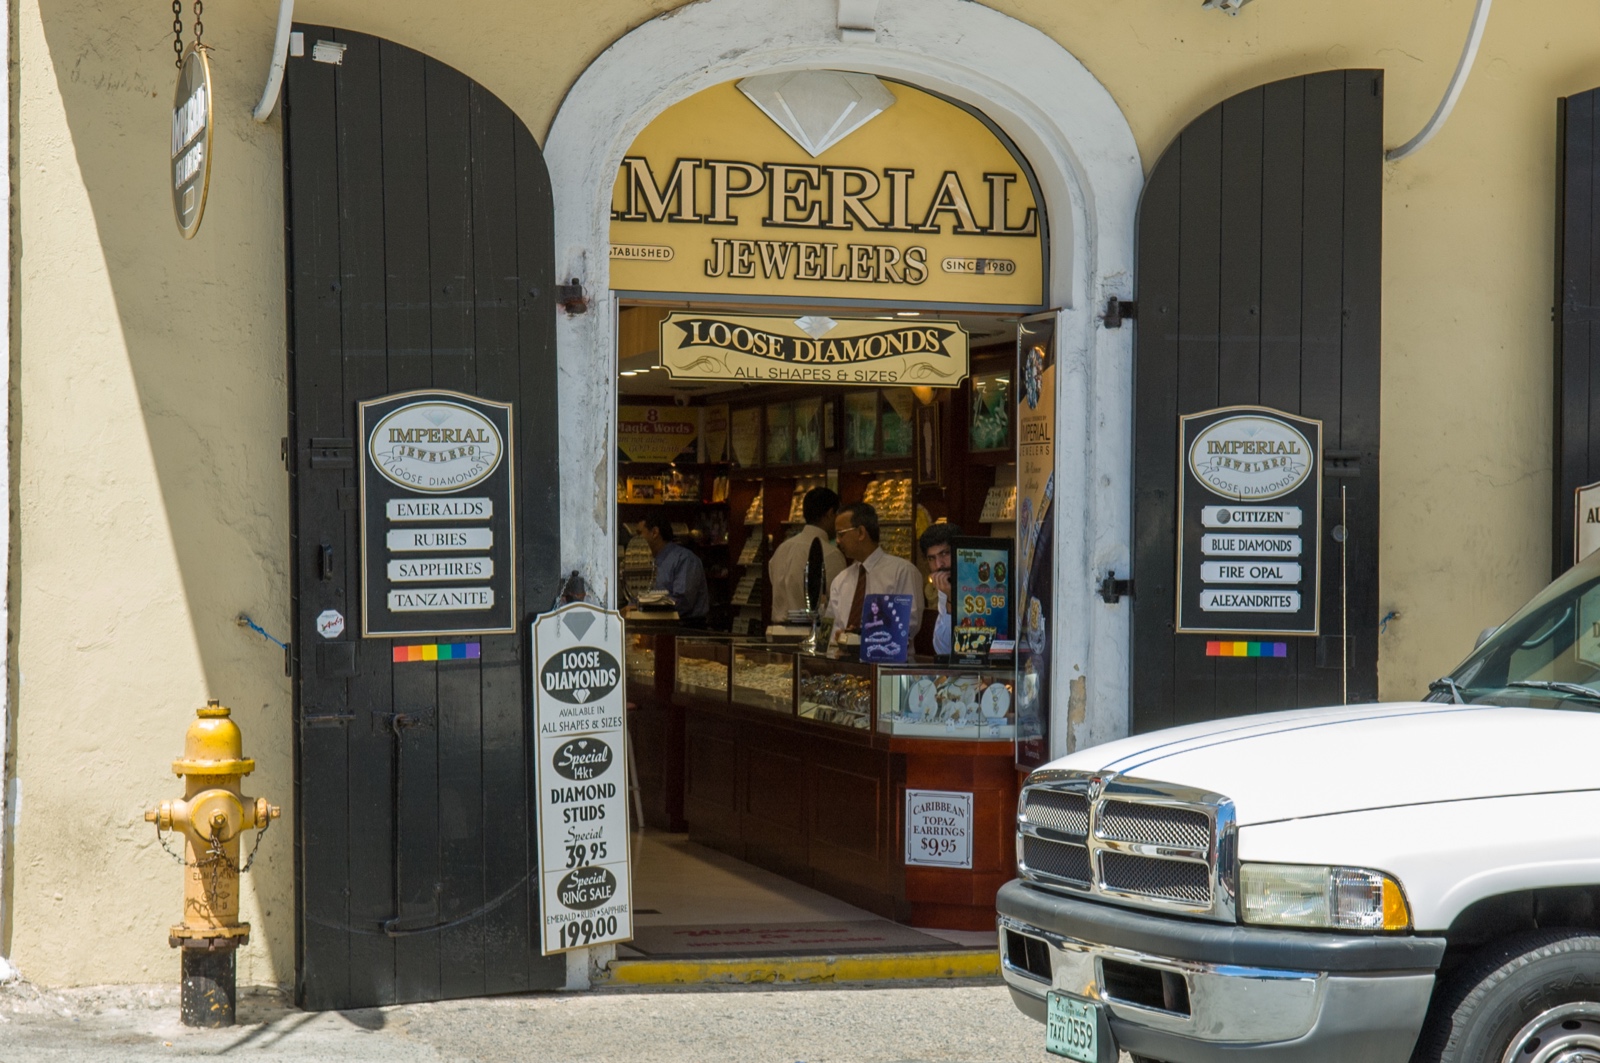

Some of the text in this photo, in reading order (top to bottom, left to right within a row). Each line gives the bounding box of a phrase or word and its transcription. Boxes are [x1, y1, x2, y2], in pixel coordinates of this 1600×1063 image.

[611, 157, 1038, 237] MPERIAL
[705, 238, 929, 285] JEWELERS
[946, 260, 1013, 272] SINCE 1980
[690, 321, 940, 363] LOOSE DIAMONDS
[734, 366, 898, 383] ALL SHAPES & SIZES
[647, 408, 659, 423] 8
[388, 428, 490, 444] IMPERIAL
[653, 423, 690, 434] Words
[398, 445, 476, 463] JEWELERS
[1207, 441, 1300, 455] IMPERIAL
[1216, 456, 1288, 473] JEWELERS
[390, 463, 484, 487] LOOSE DIAMONDS
[1208, 473, 1296, 495] LOOSE DIAMONDS
[397, 502, 483, 517] EMERALDS
[1232, 511, 1284, 523] CITIZEN
[413, 532, 467, 547] RUBIES
[1211, 539, 1292, 553] BLUE DIAMONDS
[399, 562, 482, 577] SAPPHIRES
[1219, 566, 1283, 579] FIRE OPAL
[394, 592, 488, 607] TANZANITE
[964, 594, 1005, 615] $9.95
[1210, 594, 1292, 608] ALEXANDRITES
[562, 651, 600, 670] LOOSE
[545, 668, 617, 691] DIAMONDS
[559, 705, 605, 718] AVAILABLE IN
[541, 716, 622, 734] ALL SHAPES & SIZES
[558, 744, 608, 769] Special
[574, 766, 593, 780] 14kt
[551, 783, 616, 805] DIAMOND
[563, 804, 606, 824] STUDS
[913, 801, 965, 818] CARIBBEAN
[922, 816, 956, 827] TOPAZ
[564, 826, 603, 846] Special
[913, 825, 965, 837] EARRINGS
[565, 841, 607, 869] 39.95
[921, 837, 957, 857] $9.95
[567, 870, 607, 890] Special
[562, 885, 612, 906] RING SALE
[547, 904, 628, 925] EMERALD RUBY SAPPHIRE
[559, 915, 618, 949] 199.00
[1049, 1022, 1065, 1043] TAXI
[1067, 1017, 1093, 1050] 0559
